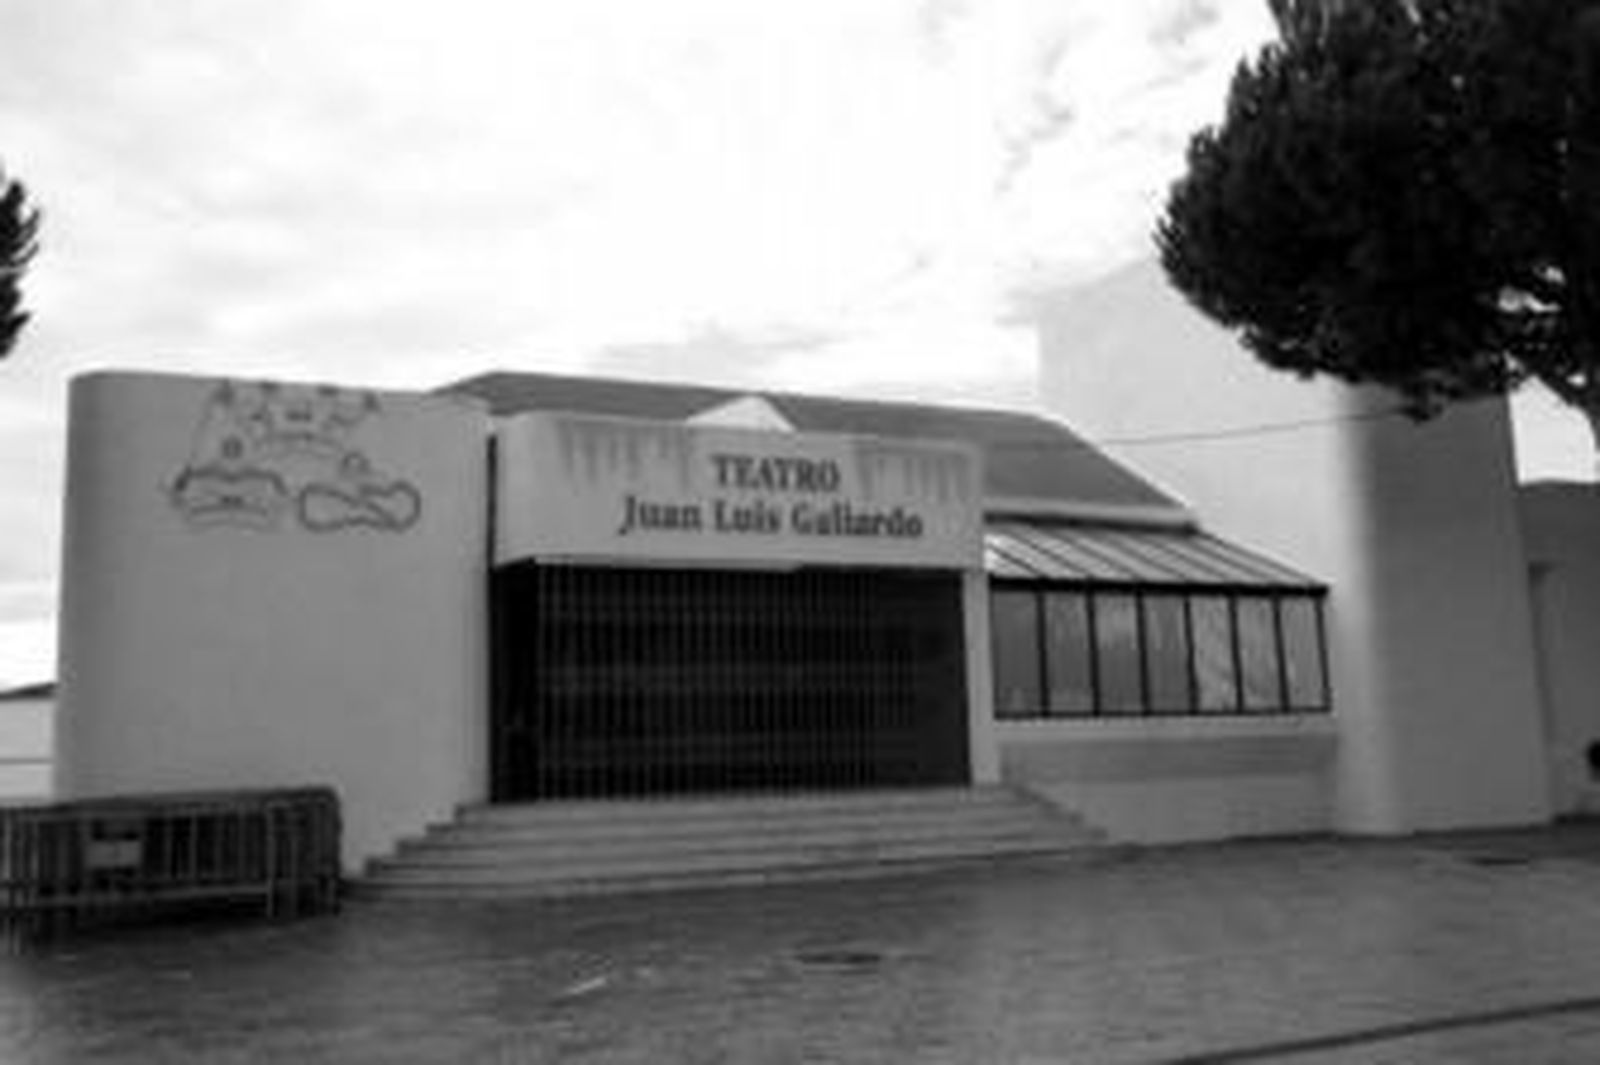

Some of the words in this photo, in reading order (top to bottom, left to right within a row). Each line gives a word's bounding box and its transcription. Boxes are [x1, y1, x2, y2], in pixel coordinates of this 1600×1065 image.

[711, 454, 841, 492] TEATRO
[618, 497, 702, 536] Juan
[715, 499, 782, 535] Luis
